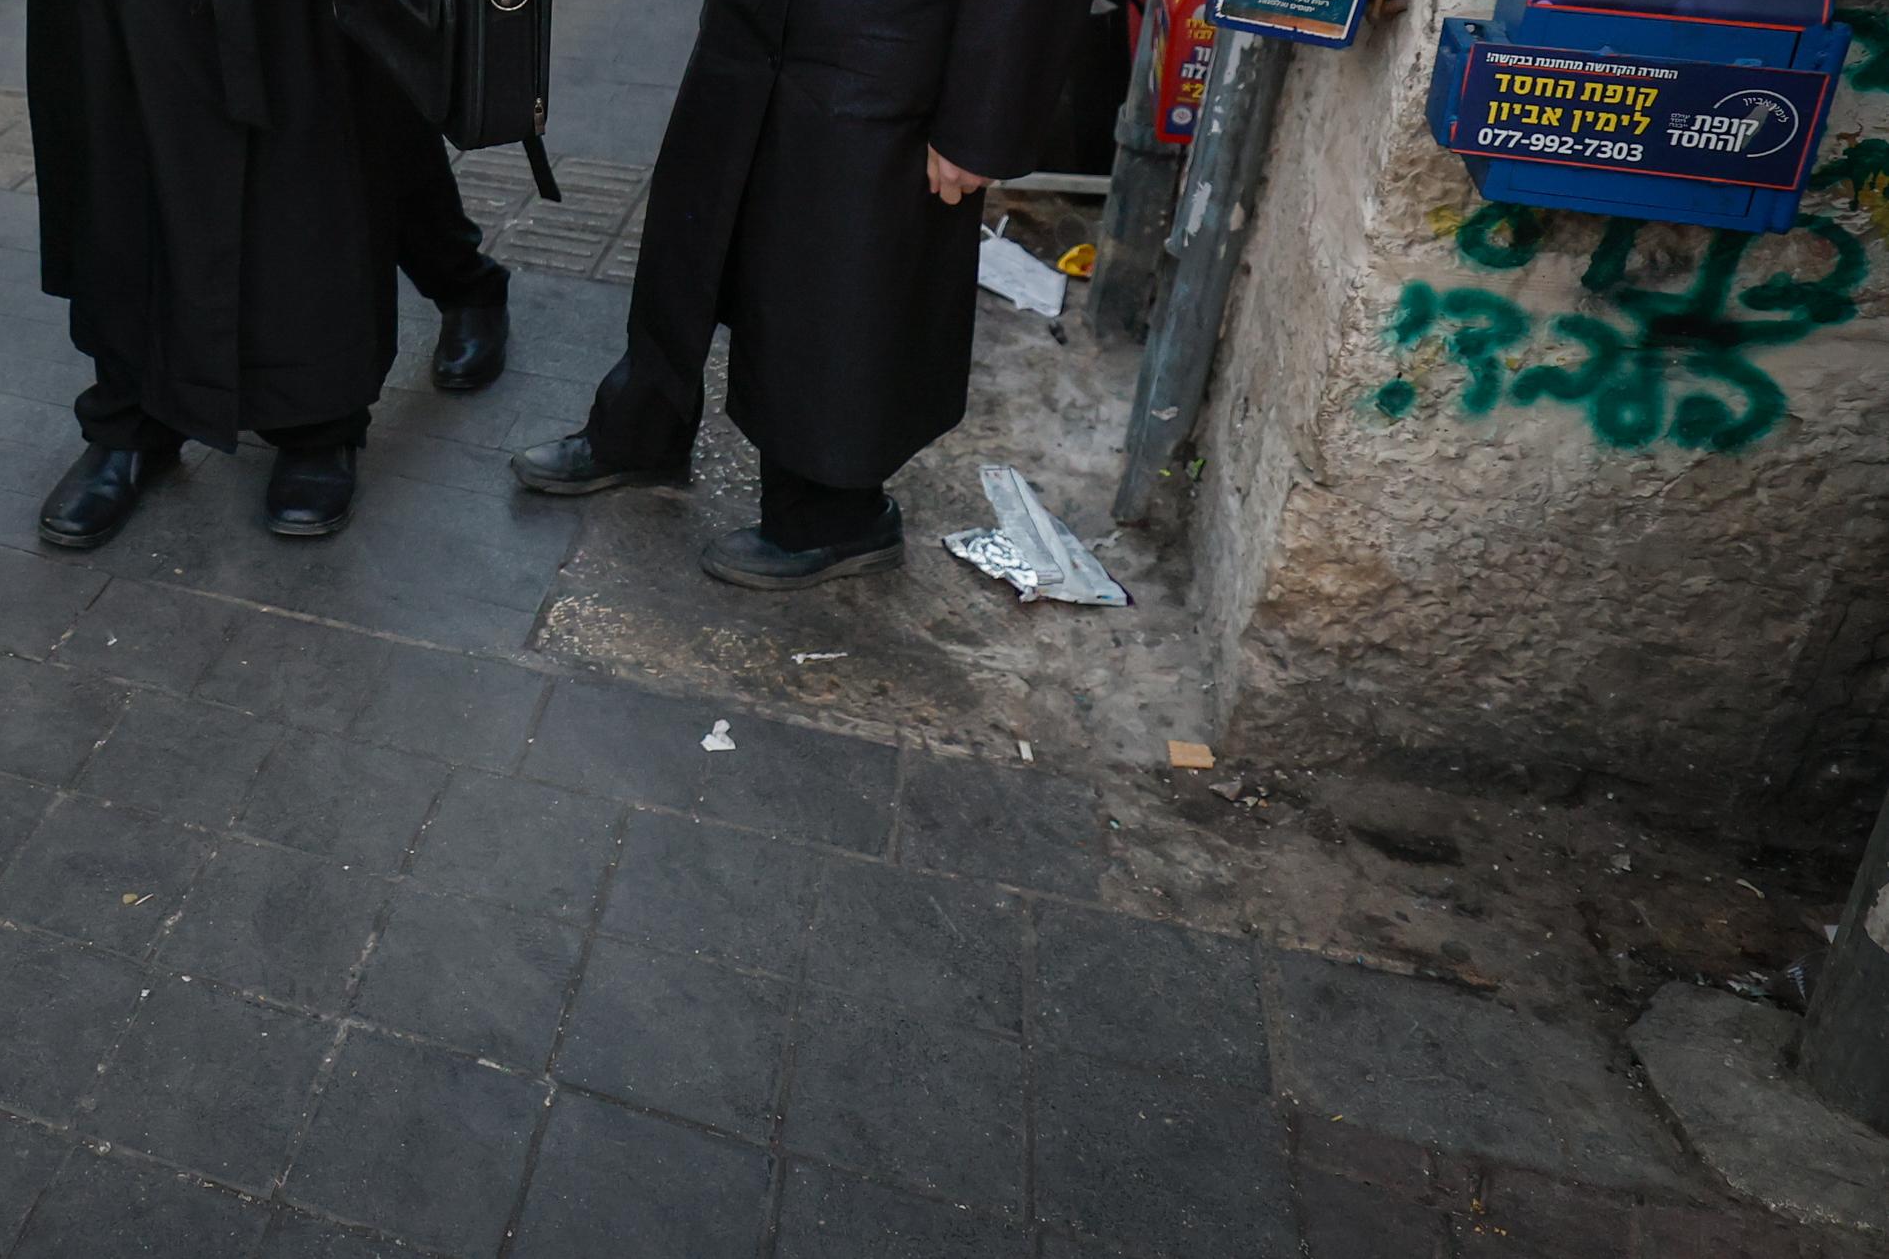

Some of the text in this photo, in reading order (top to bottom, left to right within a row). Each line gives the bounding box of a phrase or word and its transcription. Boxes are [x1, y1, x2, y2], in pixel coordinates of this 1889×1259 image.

[1485, 51, 1679, 80] התורה הקדושה מתחננת בבקשה!
[1494, 73, 1659, 111] קופת החסד
[1486, 99, 1651, 136] לימין אביון
[1690, 114, 1760, 151] קופת
[1477, 127, 1645, 163] 077-992-7303
[1666, 129, 1736, 152] החסד
